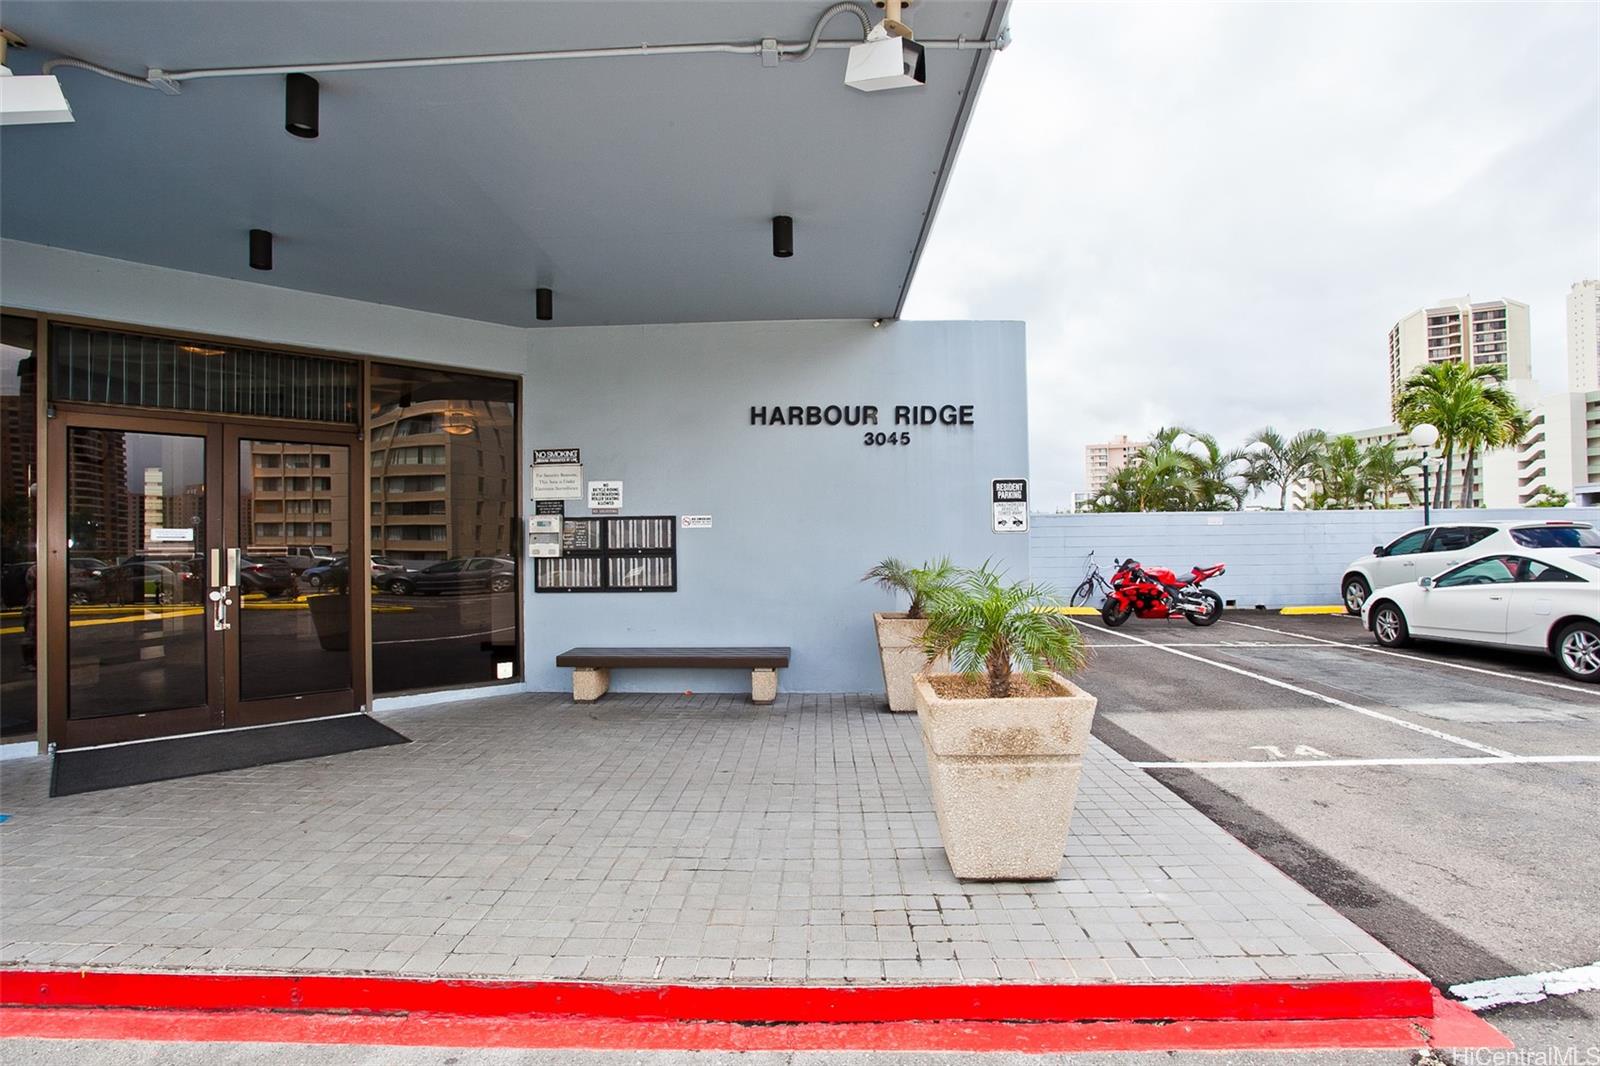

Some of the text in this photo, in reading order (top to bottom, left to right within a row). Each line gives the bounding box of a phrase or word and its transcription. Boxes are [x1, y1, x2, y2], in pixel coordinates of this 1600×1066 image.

[750, 405, 975, 426] HARBOUR RIDGE
[864, 431, 911, 446] 3045
[547, 450, 578, 458] SMOKING
[996, 482, 1023, 491] RESIDENT
[997, 491, 1022, 499] PARKING
